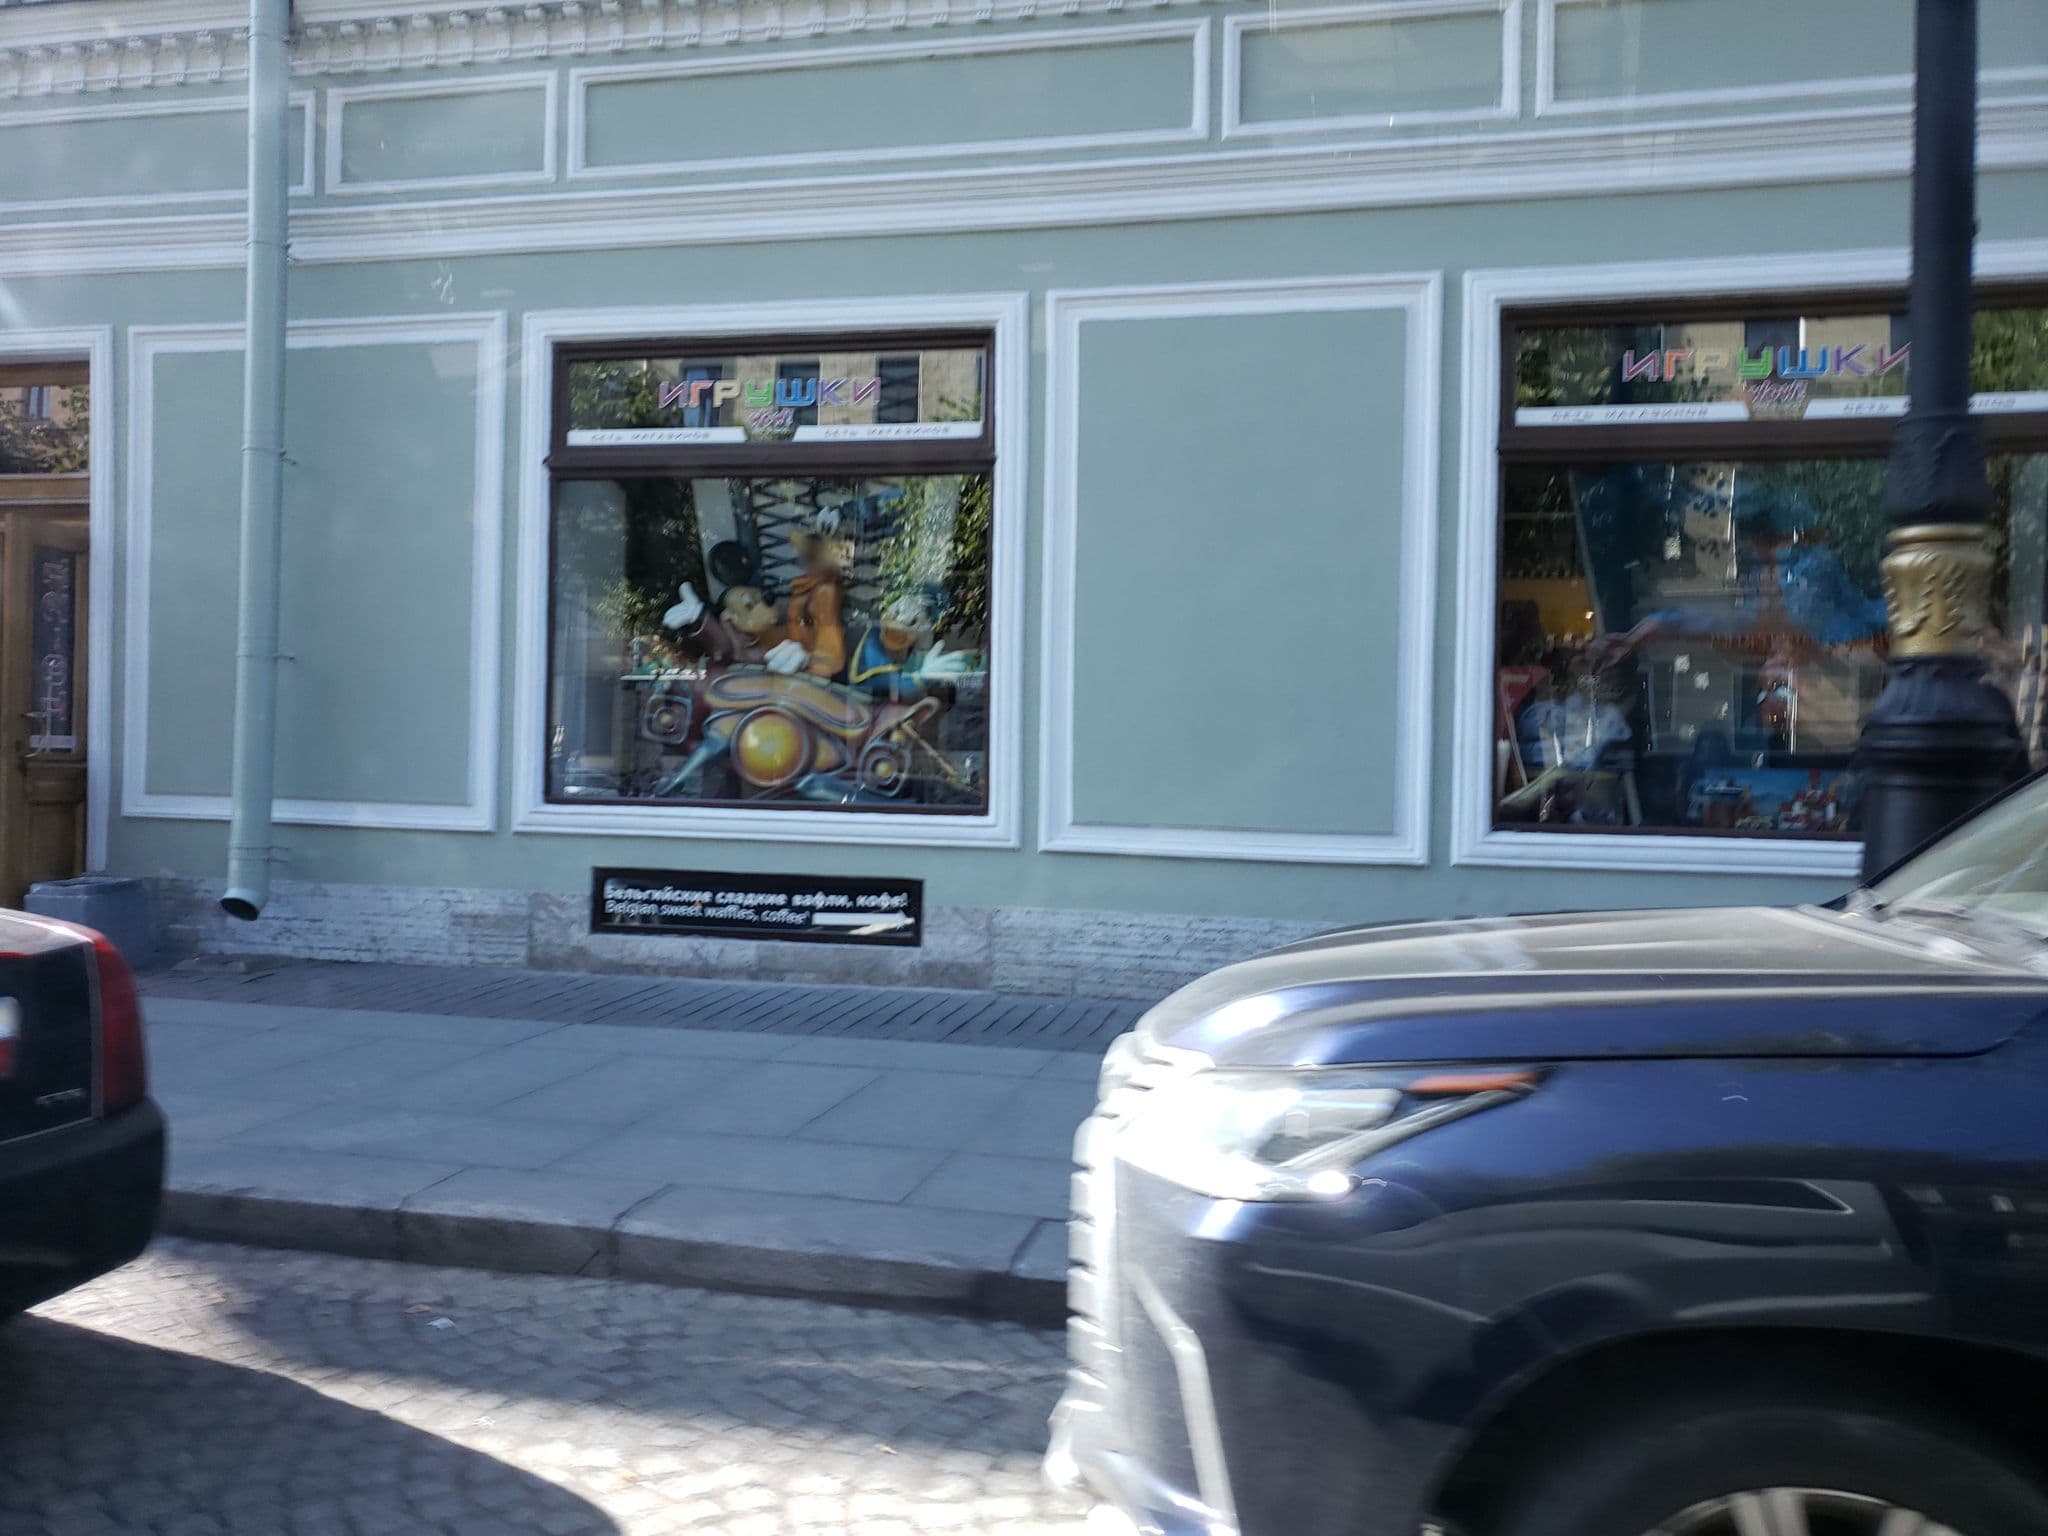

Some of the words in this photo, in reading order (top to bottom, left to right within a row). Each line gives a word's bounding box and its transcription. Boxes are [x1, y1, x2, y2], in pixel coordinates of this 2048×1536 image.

[1621, 342, 1912, 382] ИГРУШКИ
[658, 376, 882, 409] ИГРУШКИ
[604, 900, 659, 917] Belgian
[660, 903, 703, 917] sweet
[715, 891, 788, 907] сладкие
